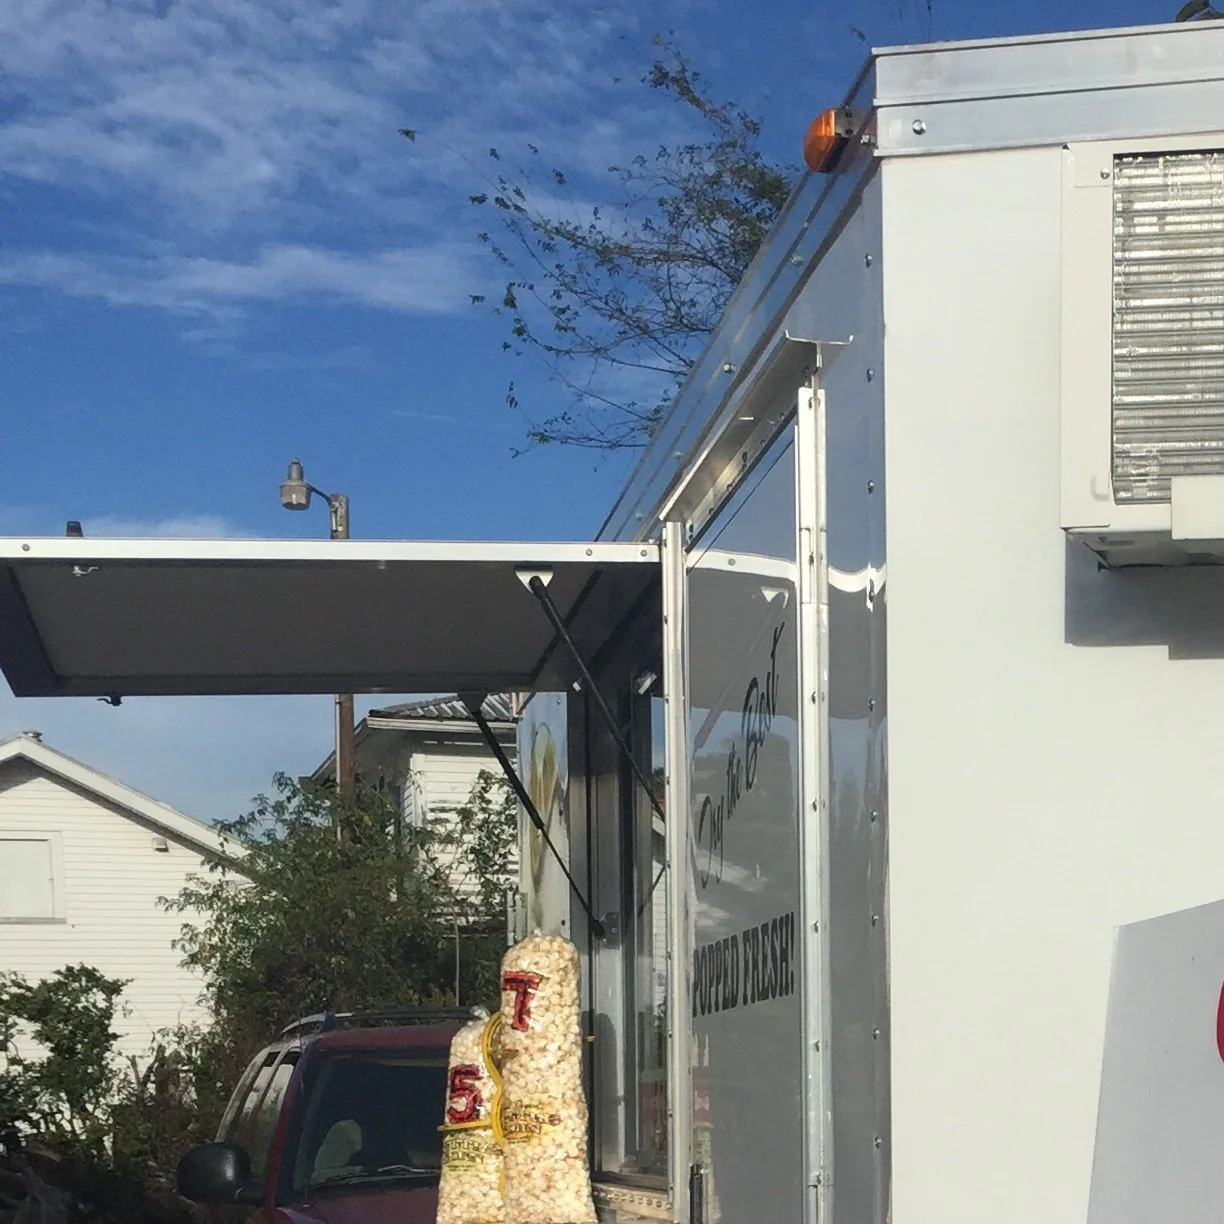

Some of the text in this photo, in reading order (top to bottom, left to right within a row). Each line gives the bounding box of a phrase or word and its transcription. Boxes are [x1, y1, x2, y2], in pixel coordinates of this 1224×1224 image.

[741, 620, 786, 792] Best
[692, 911, 795, 1018] POPPED FRESH!
[447, 1063, 482, 1124] 5
